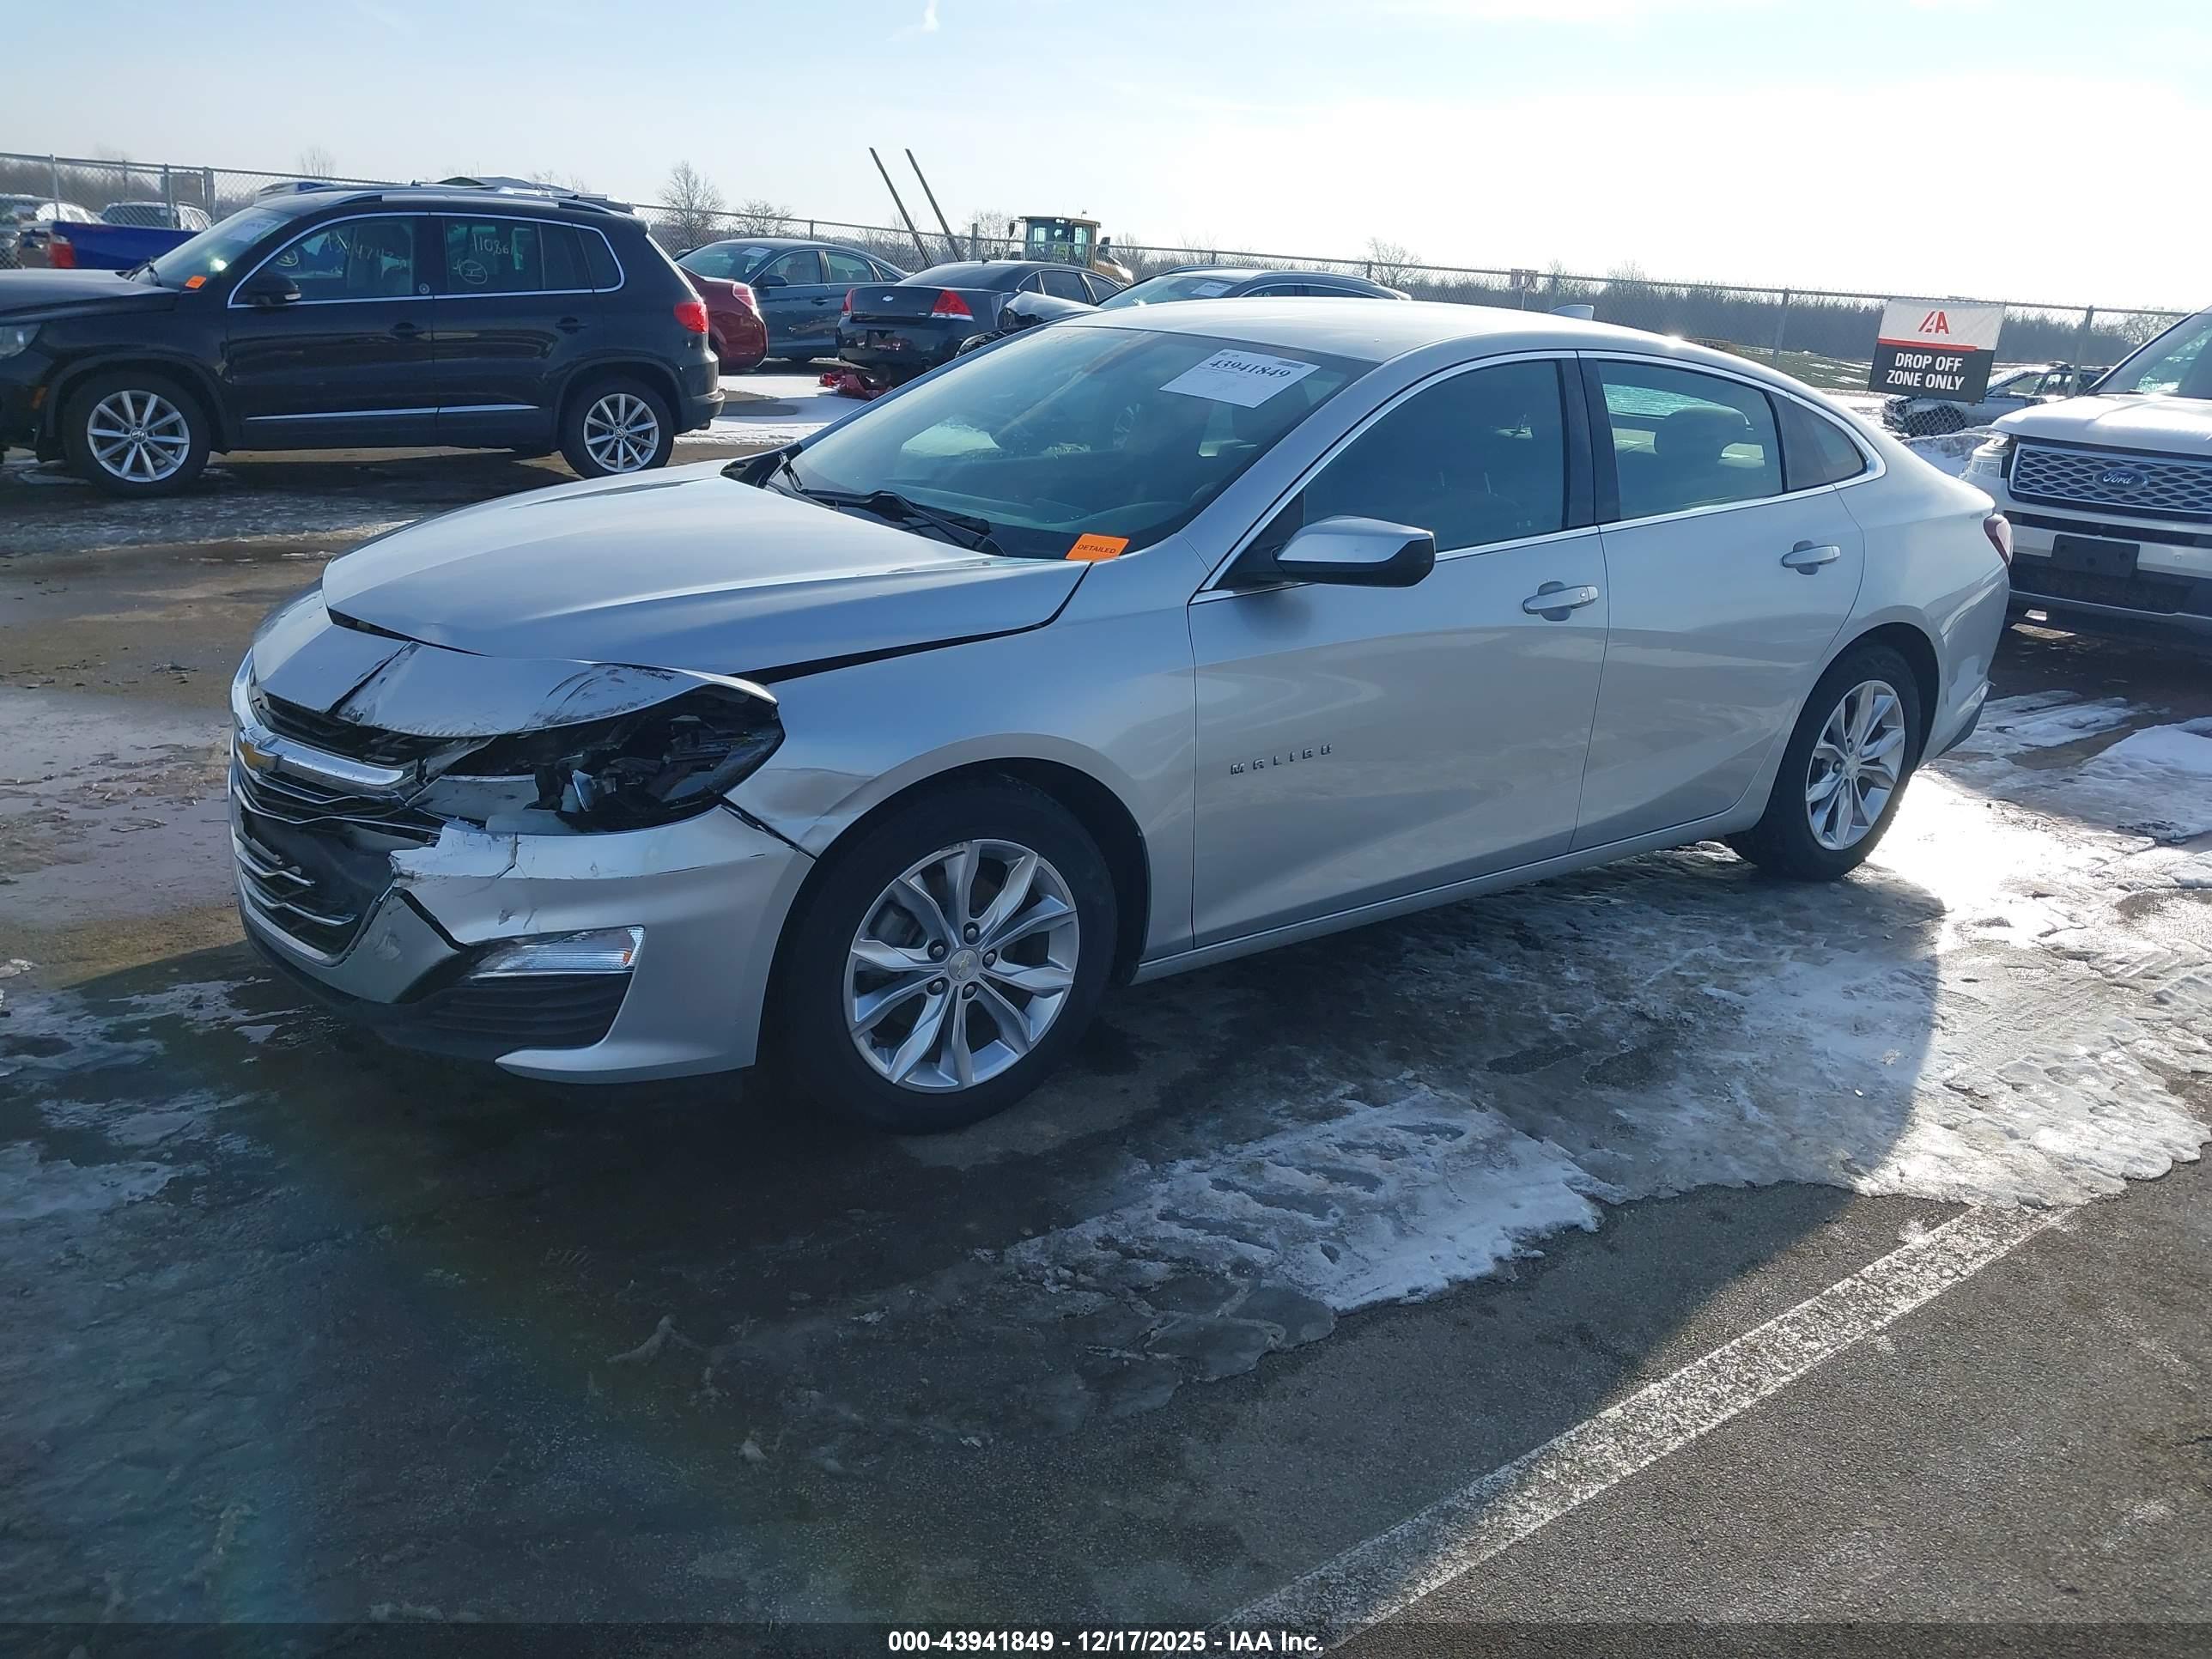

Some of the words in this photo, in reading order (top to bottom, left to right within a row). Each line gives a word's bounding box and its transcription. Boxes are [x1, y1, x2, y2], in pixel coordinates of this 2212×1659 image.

[1209, 359, 1291, 378] 43941849
[1894, 352, 1932, 369] DROP
[1936, 356, 1963, 372] OFF
[1887, 369, 1923, 387] ZONE
[1925, 374, 1965, 391] ONLY
[2103, 471, 2135, 484] Ford
[1078, 544, 1116, 554] DETAILED
[1231, 743, 1332, 775] MALIBU
